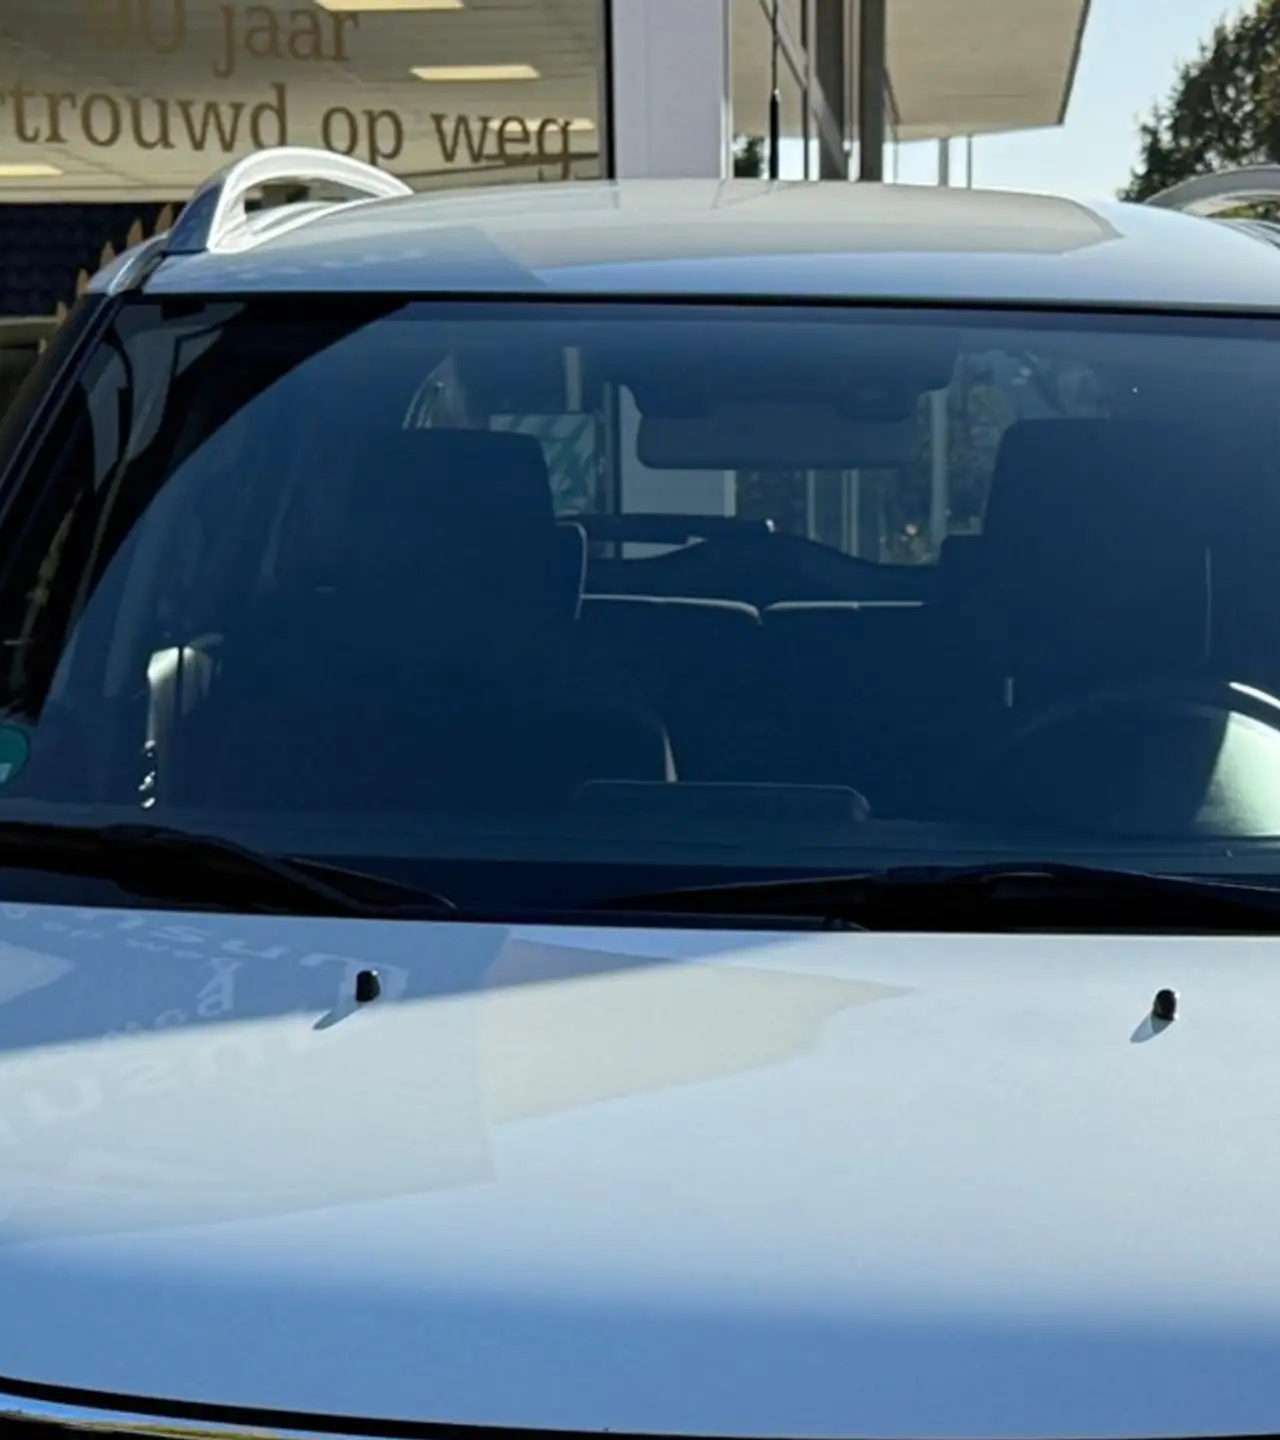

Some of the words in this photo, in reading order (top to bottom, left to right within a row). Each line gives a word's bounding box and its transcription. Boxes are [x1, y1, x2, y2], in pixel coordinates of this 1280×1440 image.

[212, 4, 361, 78] jaar
[321, 106, 403, 166] op
[430, 112, 573, 181] weg
